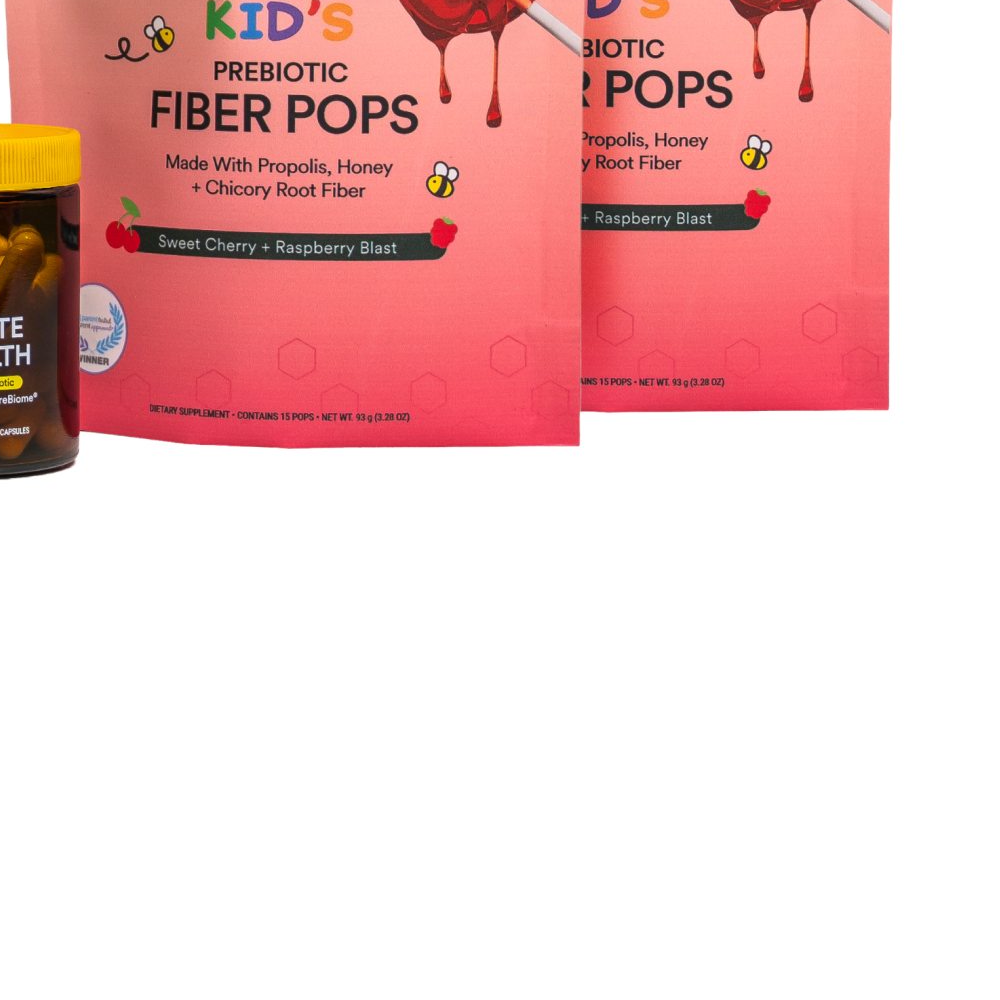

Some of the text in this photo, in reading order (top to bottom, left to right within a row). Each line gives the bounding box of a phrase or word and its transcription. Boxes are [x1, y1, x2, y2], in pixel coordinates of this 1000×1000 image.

[583, 38, 665, 59] BIOTIC
[214, 61, 348, 83] PREBIOTIC
[606, 70, 733, 109] POPS
[150, 90, 419, 135] FIBER POPS
[582, 131, 709, 151] Propolis, Honey
[165, 154, 394, 178] Made With Propolis, Honey
[595, 154, 634, 170] Root
[639, 155, 682, 170] Fiber
[205, 179, 366, 200] Chicory Root Fiber
[595, 210, 713, 228] Raspberry Blast
[158, 234, 397, 257] Sweet Cherry Raspberry Blast
[149, 404, 410, 423] DIETARY SUPPLEMENT CONTAINS 15 POPS NET WT. 93 (3.28 OZ)
[0, 427, 30, 436] CAPSULES
